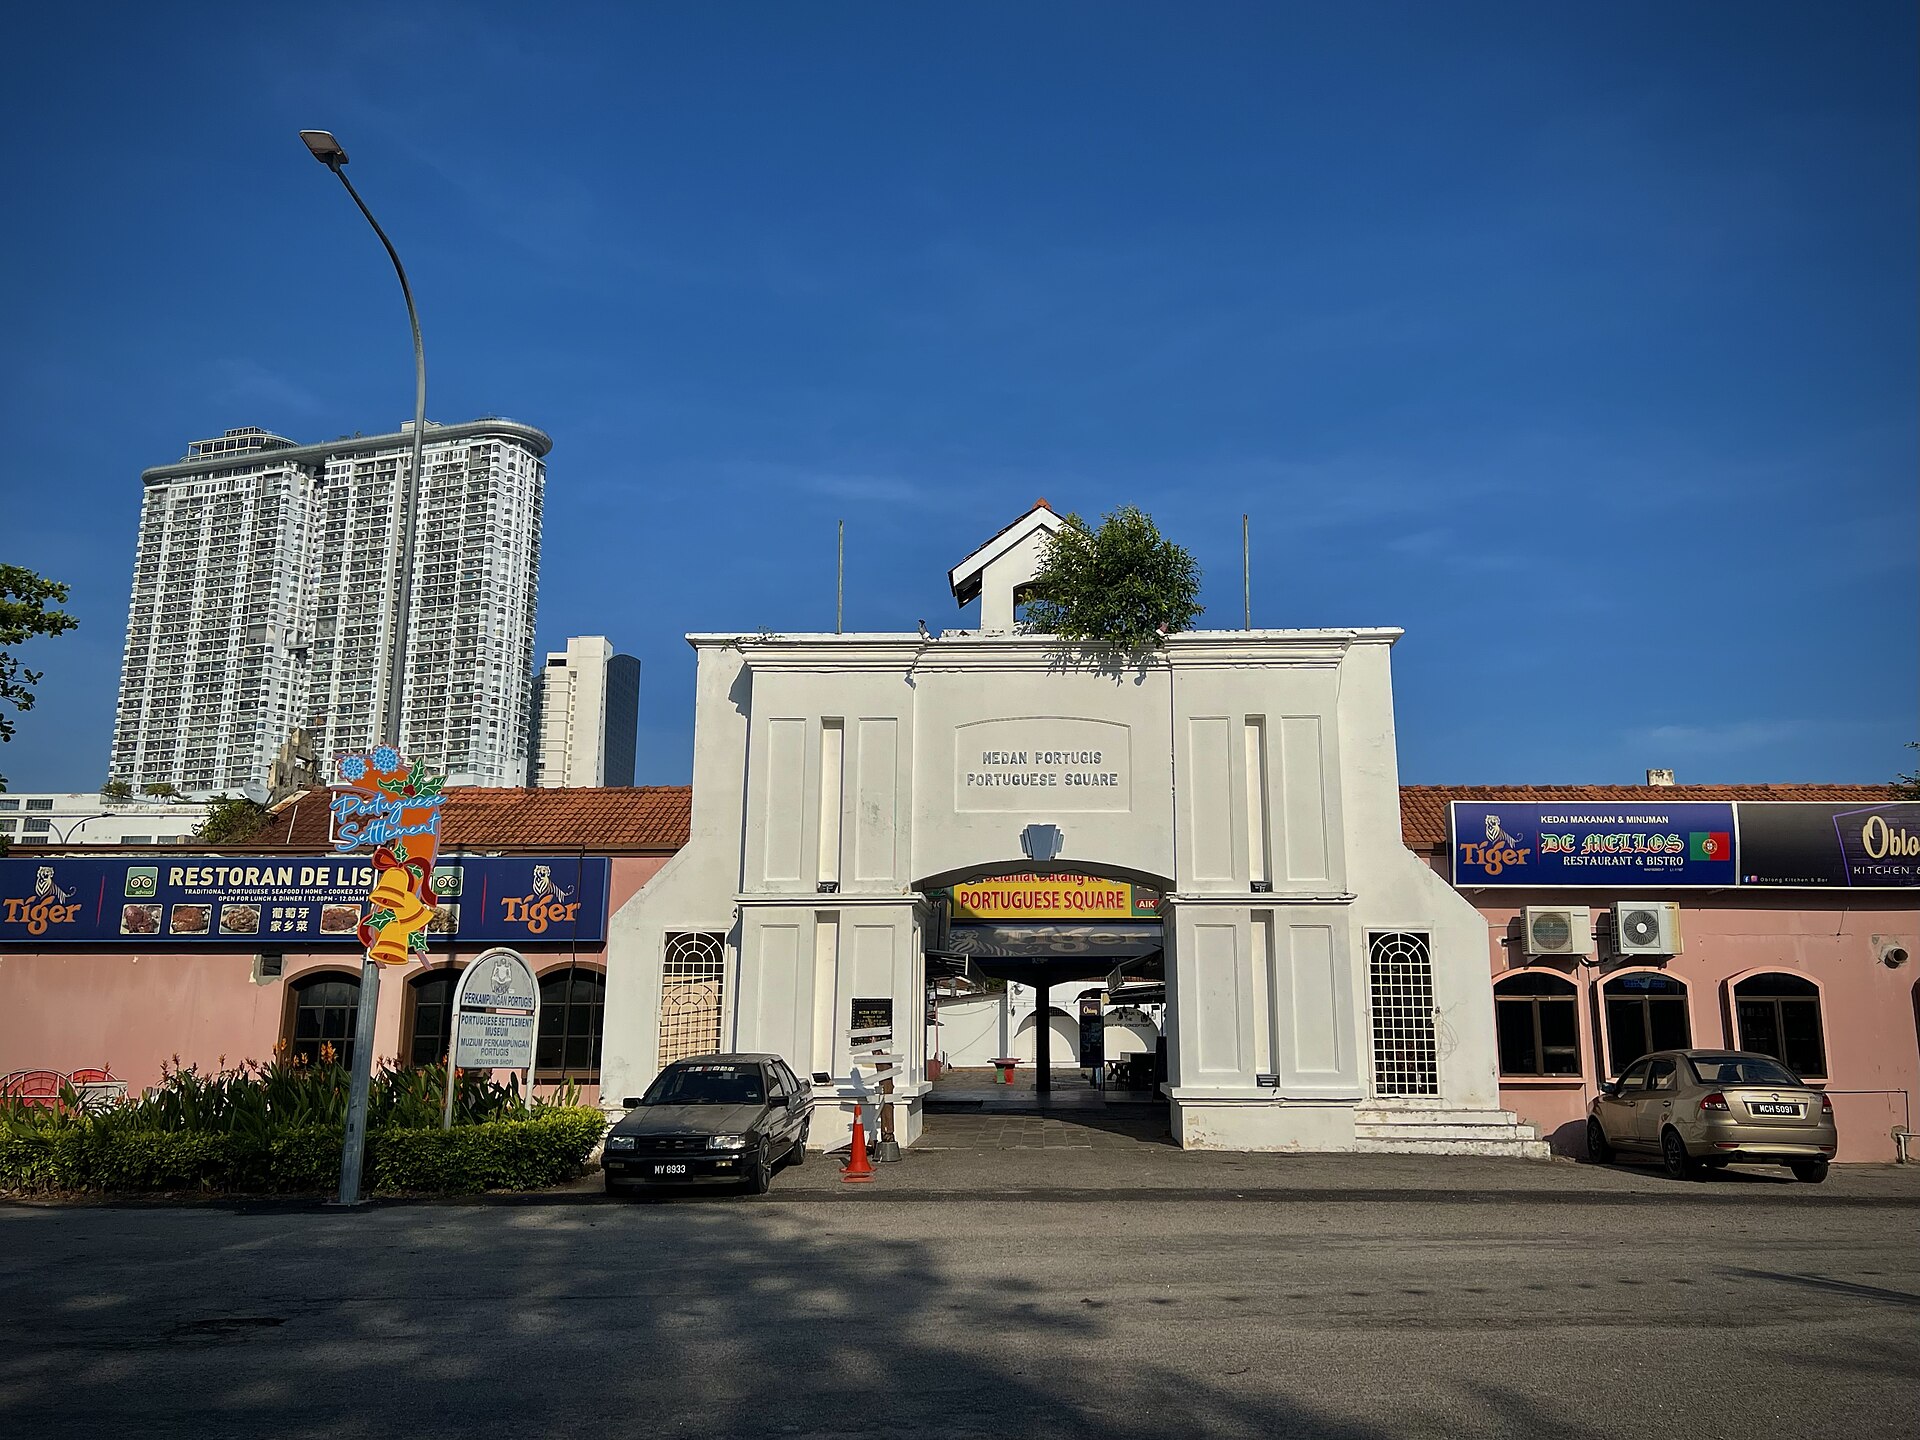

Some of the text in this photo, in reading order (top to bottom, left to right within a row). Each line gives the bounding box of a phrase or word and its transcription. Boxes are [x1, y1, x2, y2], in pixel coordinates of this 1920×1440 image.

[982, 751, 1102, 765] MEDAN PORTUGIS
[967, 773, 1118, 786] PORTUGUESE SQUARE
[330, 792, 447, 824] Portuguese
[1541, 816, 1669, 824] KEDAI MAKANAN & MINUMAN
[336, 812, 441, 852] Settlement
[1541, 833, 1684, 855] DE MELLOS
[1460, 840, 1531, 875] Tiger
[1563, 856, 1684, 866] RESTAURANT & BISTRO
[169, 867, 293, 886] RESTORAN
[300, 867, 329, 886] DE
[1853, 866, 1910, 875] KITCHEN
[960, 891, 1125, 911] PORTUGUESE SQUARE
[1138, 900, 1155, 908] AIK
[3, 897, 82, 935] Tiger
[271, 907, 310, 919] 葡萄牙
[501, 895, 582, 934] Tiger
[269, 920, 309, 932] 家乡菜
[464, 992, 532, 1007] PERKAMPUNGAN PORTUGIS
[461, 1015, 533, 1027] PORTUGUESE SETTLEMENT
[485, 1027, 509, 1036] MUSEUM
[461, 1038, 530, 1048] MUZIUM PERKAMPUNGAN
[480, 1047, 509, 1056] PORTUGIS
[666, 1164, 685, 1174] 8933
